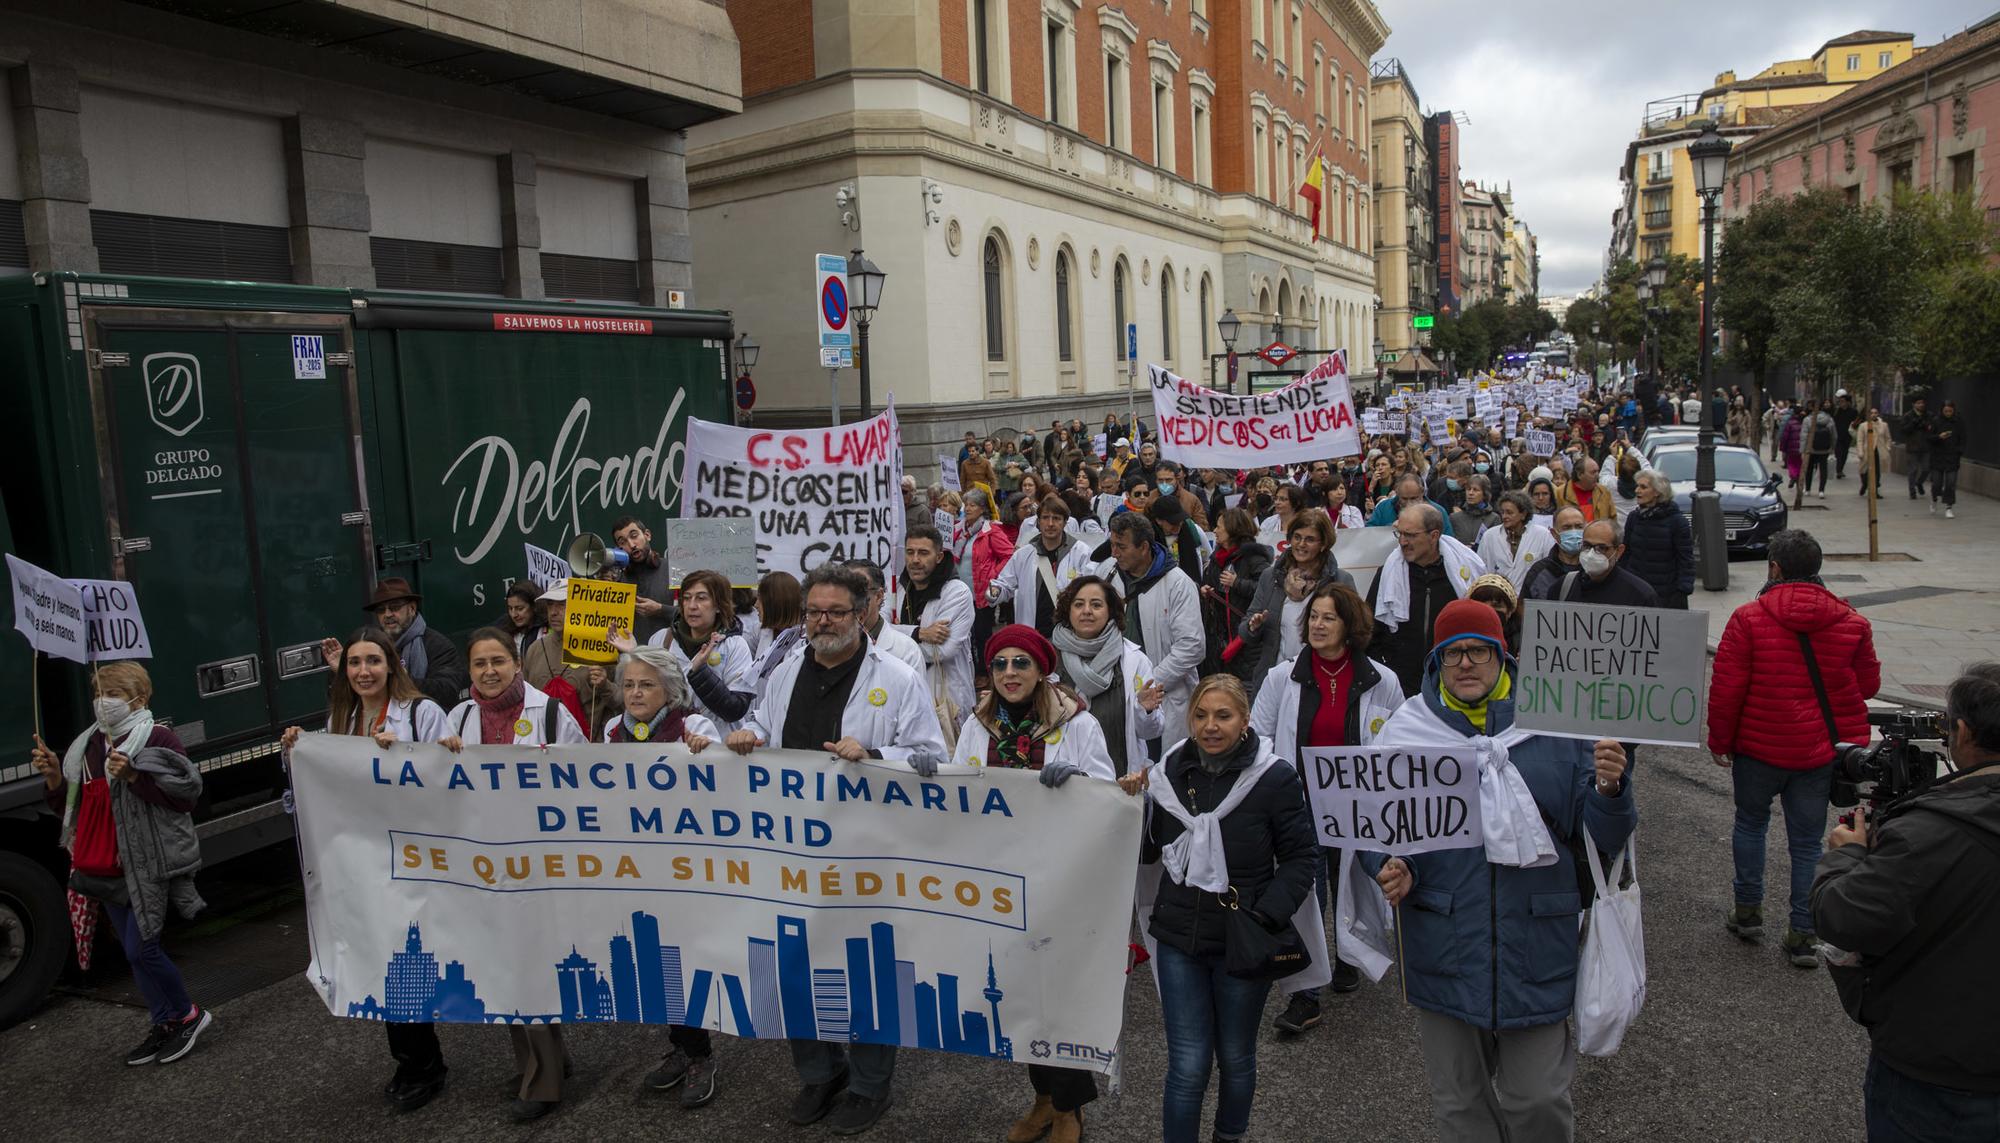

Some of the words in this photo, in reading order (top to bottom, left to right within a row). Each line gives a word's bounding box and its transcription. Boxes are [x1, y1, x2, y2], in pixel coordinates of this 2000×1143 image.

[503, 316, 564, 329] SALVEMOS
[567, 318, 580, 329] LA
[584, 319, 646, 332] HOSTELERÍA
[293, 336, 323, 359] FRAX
[1151, 368, 1175, 391] LA
[1176, 395, 1206, 416] SE
[1210, 380, 1329, 417] DEFIENDE
[1269, 424, 1292, 440] en
[1294, 402, 1353, 443] LUCHA
[155, 449, 210, 465] GRUPO
[747, 432, 810, 471] C.S.
[145, 465, 222, 484] DELGADO
[442, 386, 688, 565] Delgado
[760, 509, 810, 537] UNA
[571, 584, 630, 604] Privatizar
[41, 618, 55, 635] seis
[55, 624, 77, 643] manos.
[570, 612, 581, 626] es
[583, 611, 629, 629] robarnos
[1536, 609, 1661, 650] NINGÚN
[568, 634, 577, 650] lo
[1535, 645, 1659, 678] PACIENTE
[1518, 675, 1563, 714] SIN
[1573, 676, 1697, 726] MÉDICO
[372, 756, 424, 789] LA
[447, 755, 717, 792] ATENCIÓN
[748, 764, 1014, 818] PRIMARIA
[1315, 752, 1462, 792] DERECHO
[536, 805, 601, 833] DE
[630, 805, 833, 847] MADRID
[1322, 814, 1346, 838] a
[1352, 799, 1376, 839] la
[1381, 795, 1470, 846] SALUD.
[403, 843, 450, 872] SE
[472, 853, 642, 885] QUEDA
[671, 856, 750, 885] SIN
[781, 864, 1014, 914] MÉDICOS
